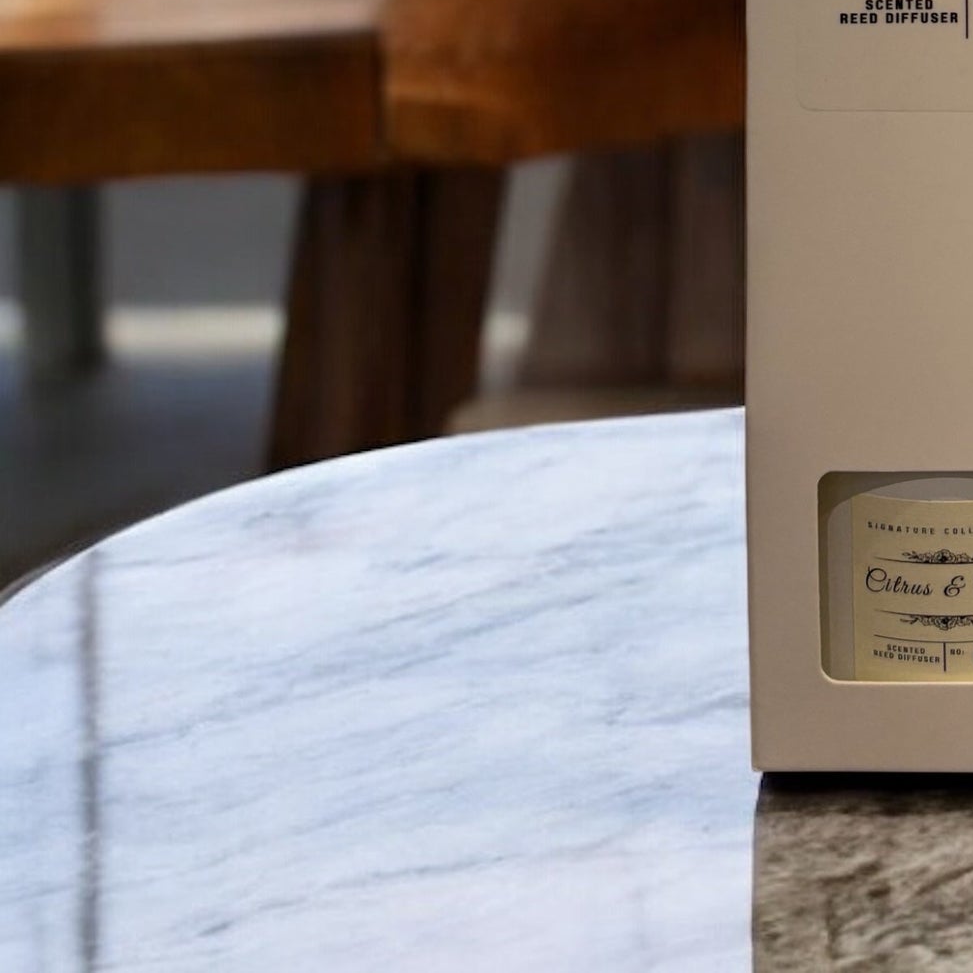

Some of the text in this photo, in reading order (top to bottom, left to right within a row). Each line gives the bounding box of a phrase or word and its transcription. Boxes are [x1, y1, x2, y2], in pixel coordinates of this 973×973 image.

[840, 13, 958, 24] REED DIFFUSER
[868, 522, 934, 535] SIGNATURE
[866, 567, 933, 596] Citrus
[944, 575, 966, 597] &
[887, 644, 925, 654] SCENTED
[873, 650, 940, 663] REED DIFFUSER
